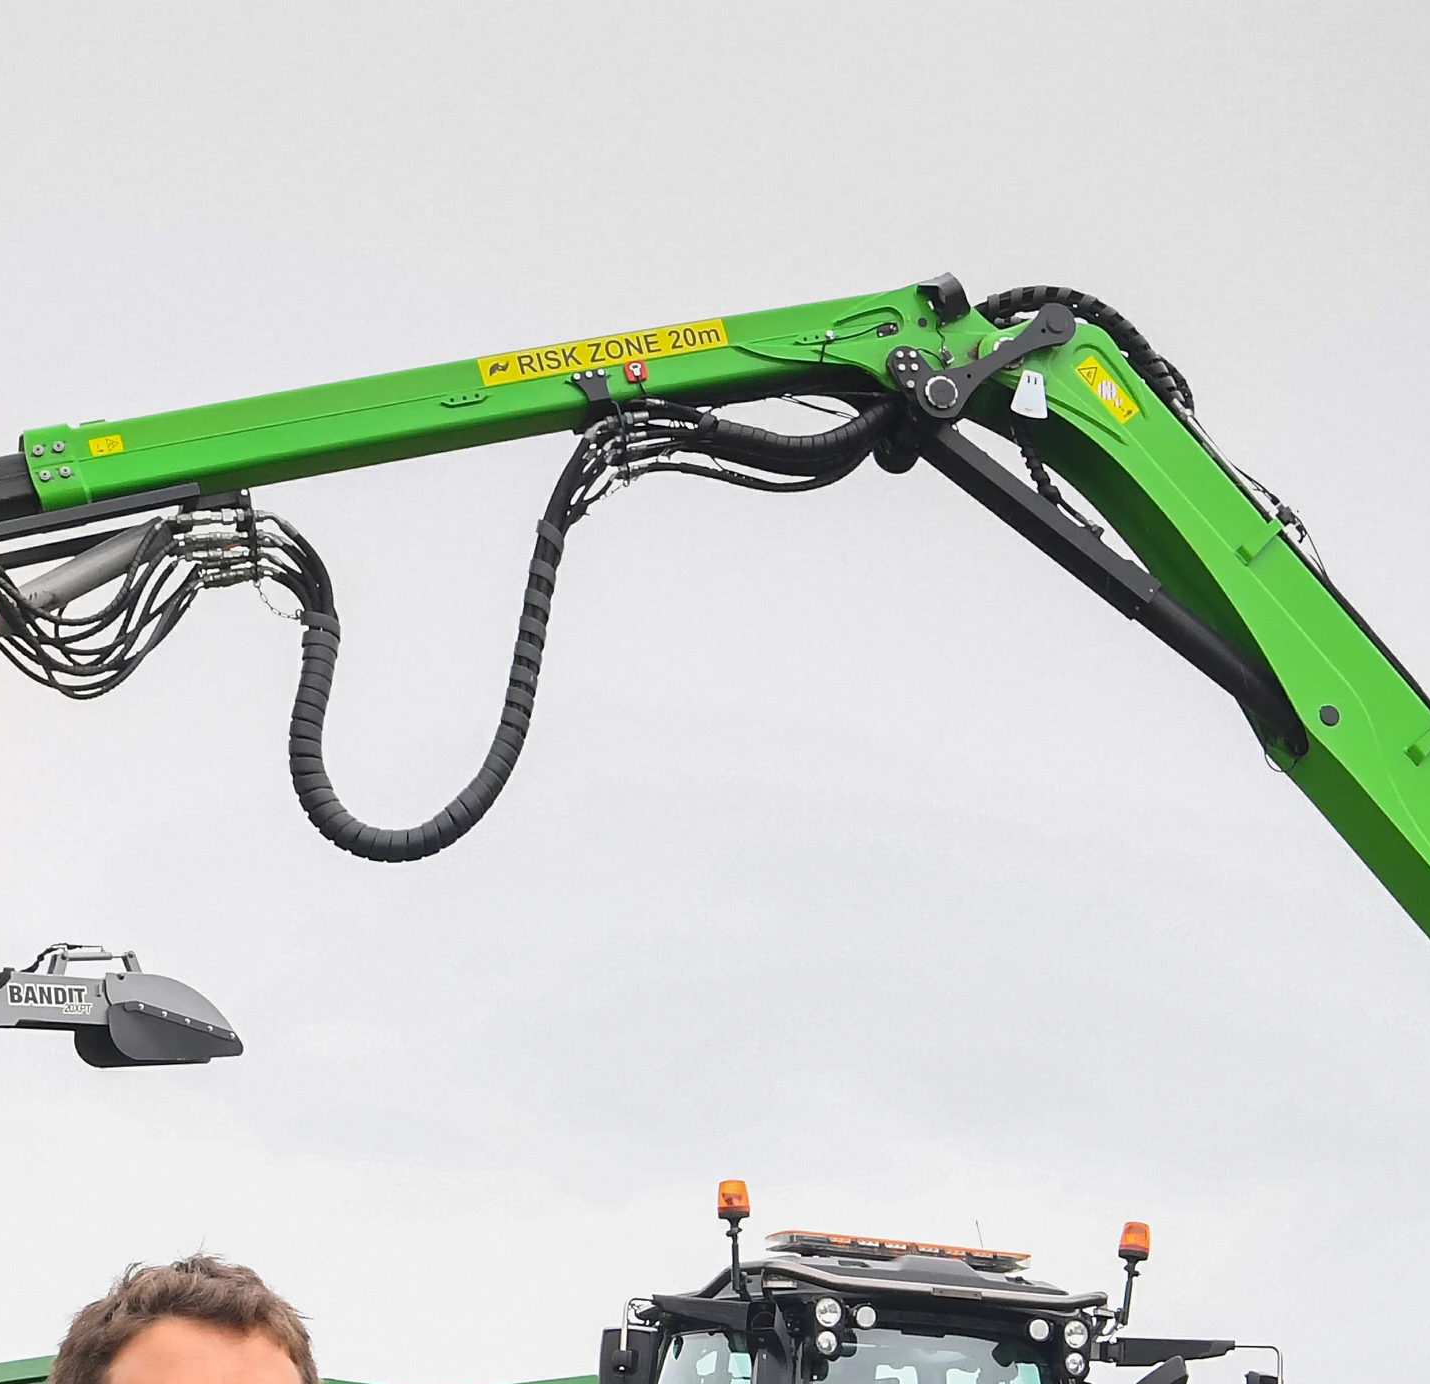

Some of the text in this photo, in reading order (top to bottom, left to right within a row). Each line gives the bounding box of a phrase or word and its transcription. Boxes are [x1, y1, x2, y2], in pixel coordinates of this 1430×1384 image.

[516, 327, 720, 375] RISK ZONE 20m
[8, 984, 86, 1006] BANDIT
[64, 1003, 92, 1014] 20XPT
